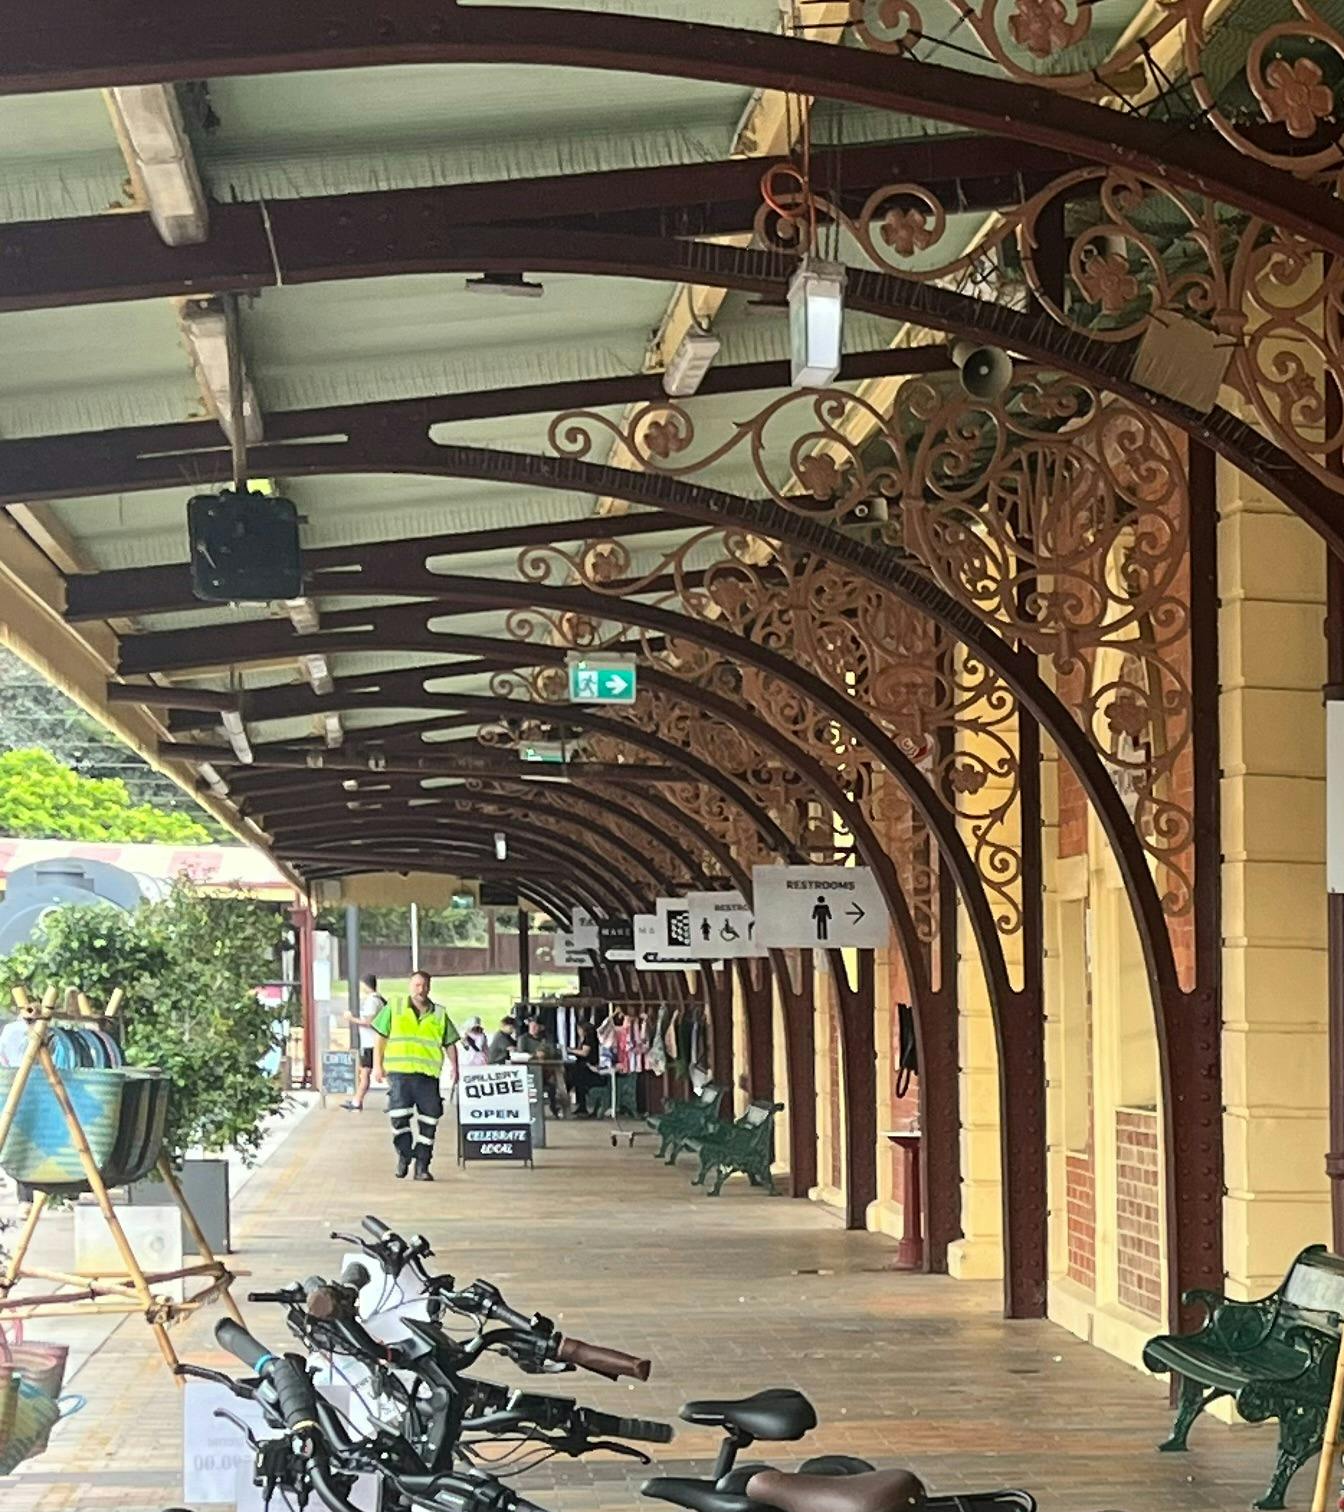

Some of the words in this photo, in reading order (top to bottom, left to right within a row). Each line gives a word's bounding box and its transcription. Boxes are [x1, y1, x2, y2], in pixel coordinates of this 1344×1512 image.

[786, 880, 855, 890] RESTROOMS
[463, 1070, 519, 1084] GALLERY
[465, 1080, 524, 1099] QUBE
[470, 1109, 519, 1119] OPEN
